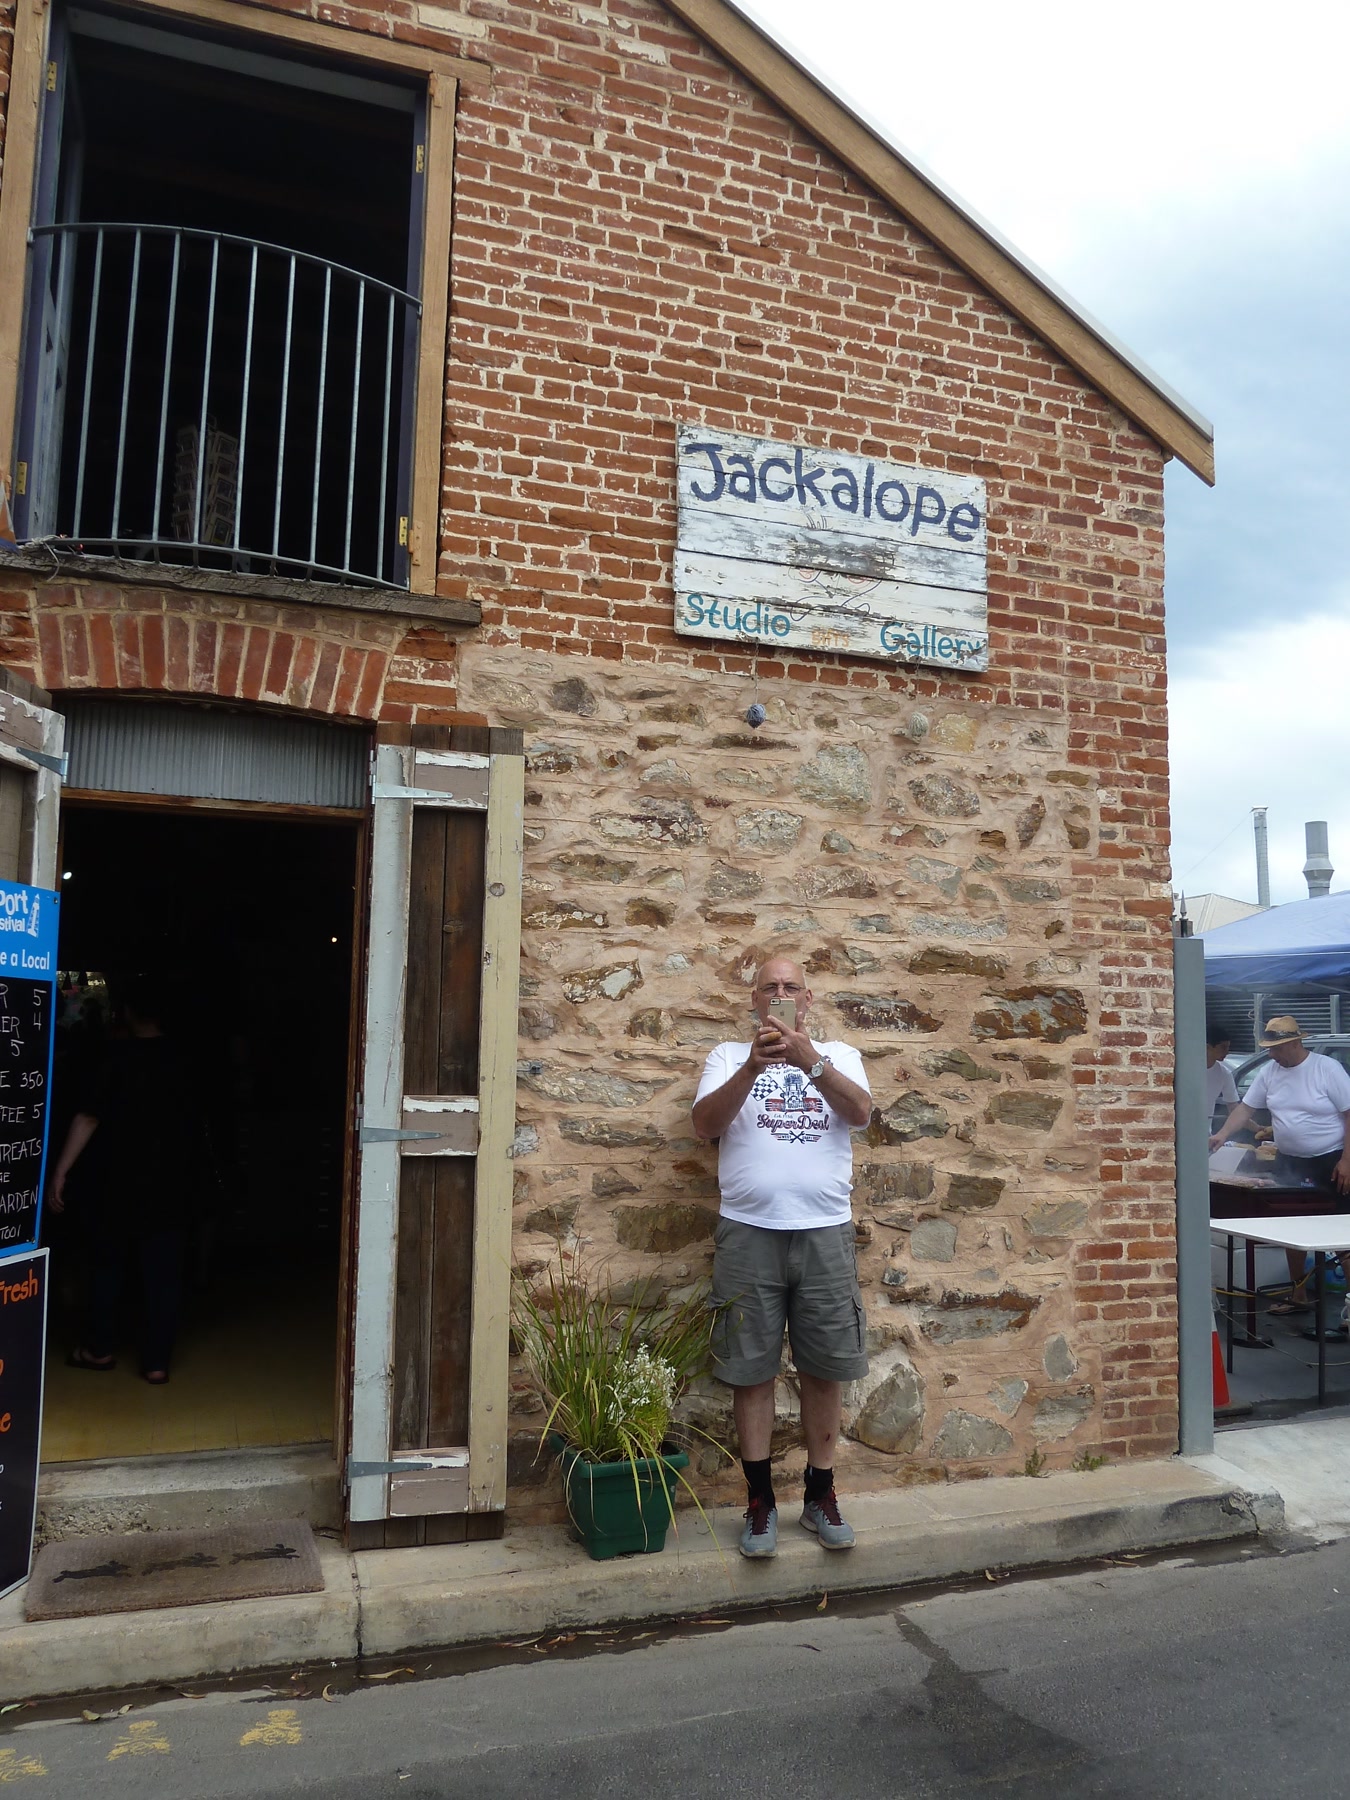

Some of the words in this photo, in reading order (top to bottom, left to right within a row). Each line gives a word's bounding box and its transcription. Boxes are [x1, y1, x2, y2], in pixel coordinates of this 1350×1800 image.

[685, 443, 980, 542] Jackalope
[684, 593, 791, 637] Studio
[11, 953, 18, 967] a
[22, 949, 50, 970] Local
[33, 988, 47, 1006] 5
[0, 1016, 20, 1038] ER
[33, 1012, 42, 1031] 4
[11, 1039, 24, 1057] 5
[32, 1102, 44, 1119] 5
